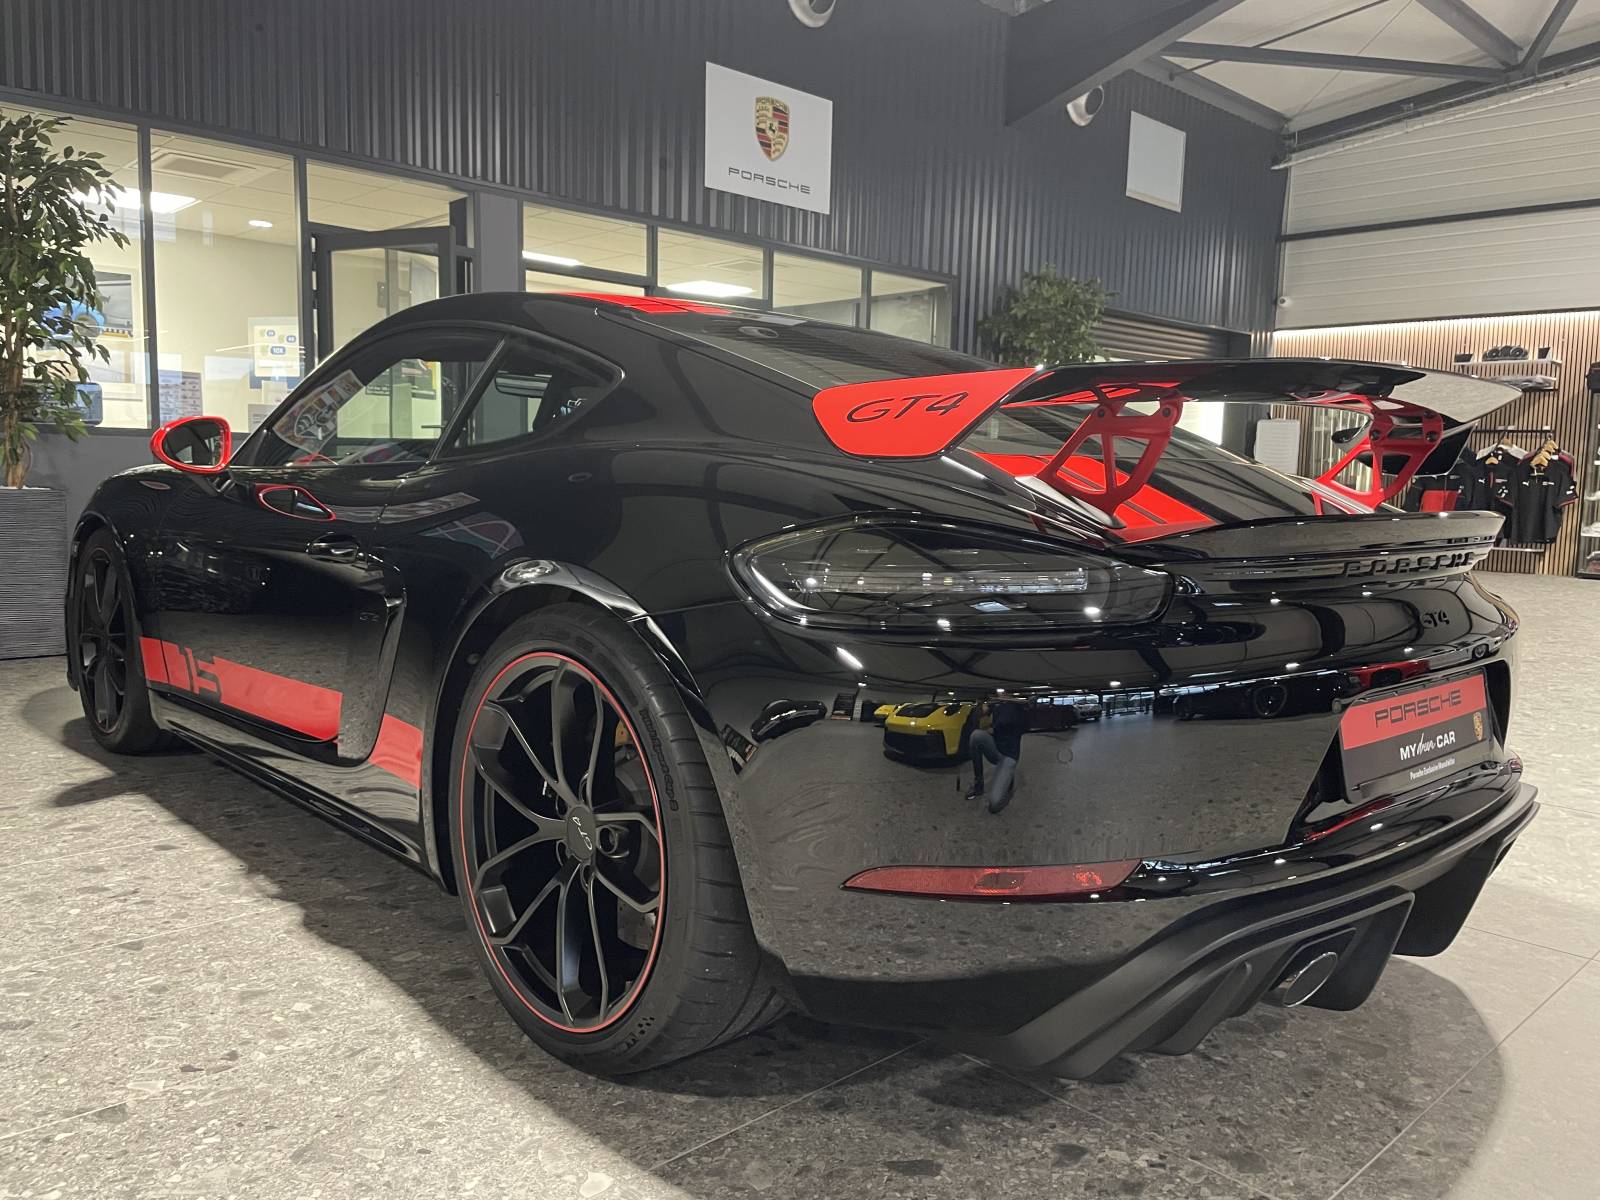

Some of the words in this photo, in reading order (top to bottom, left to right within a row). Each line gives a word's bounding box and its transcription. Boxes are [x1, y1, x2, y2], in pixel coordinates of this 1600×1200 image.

[728, 167, 811, 195] PORSCHE
[847, 392, 969, 422] GT4
[1344, 552, 1474, 577] PORSCHE
[1375, 689, 1461, 728] PORSCHE
[1400, 744, 1417, 760] MY
[1436, 731, 1456, 748] CAR
